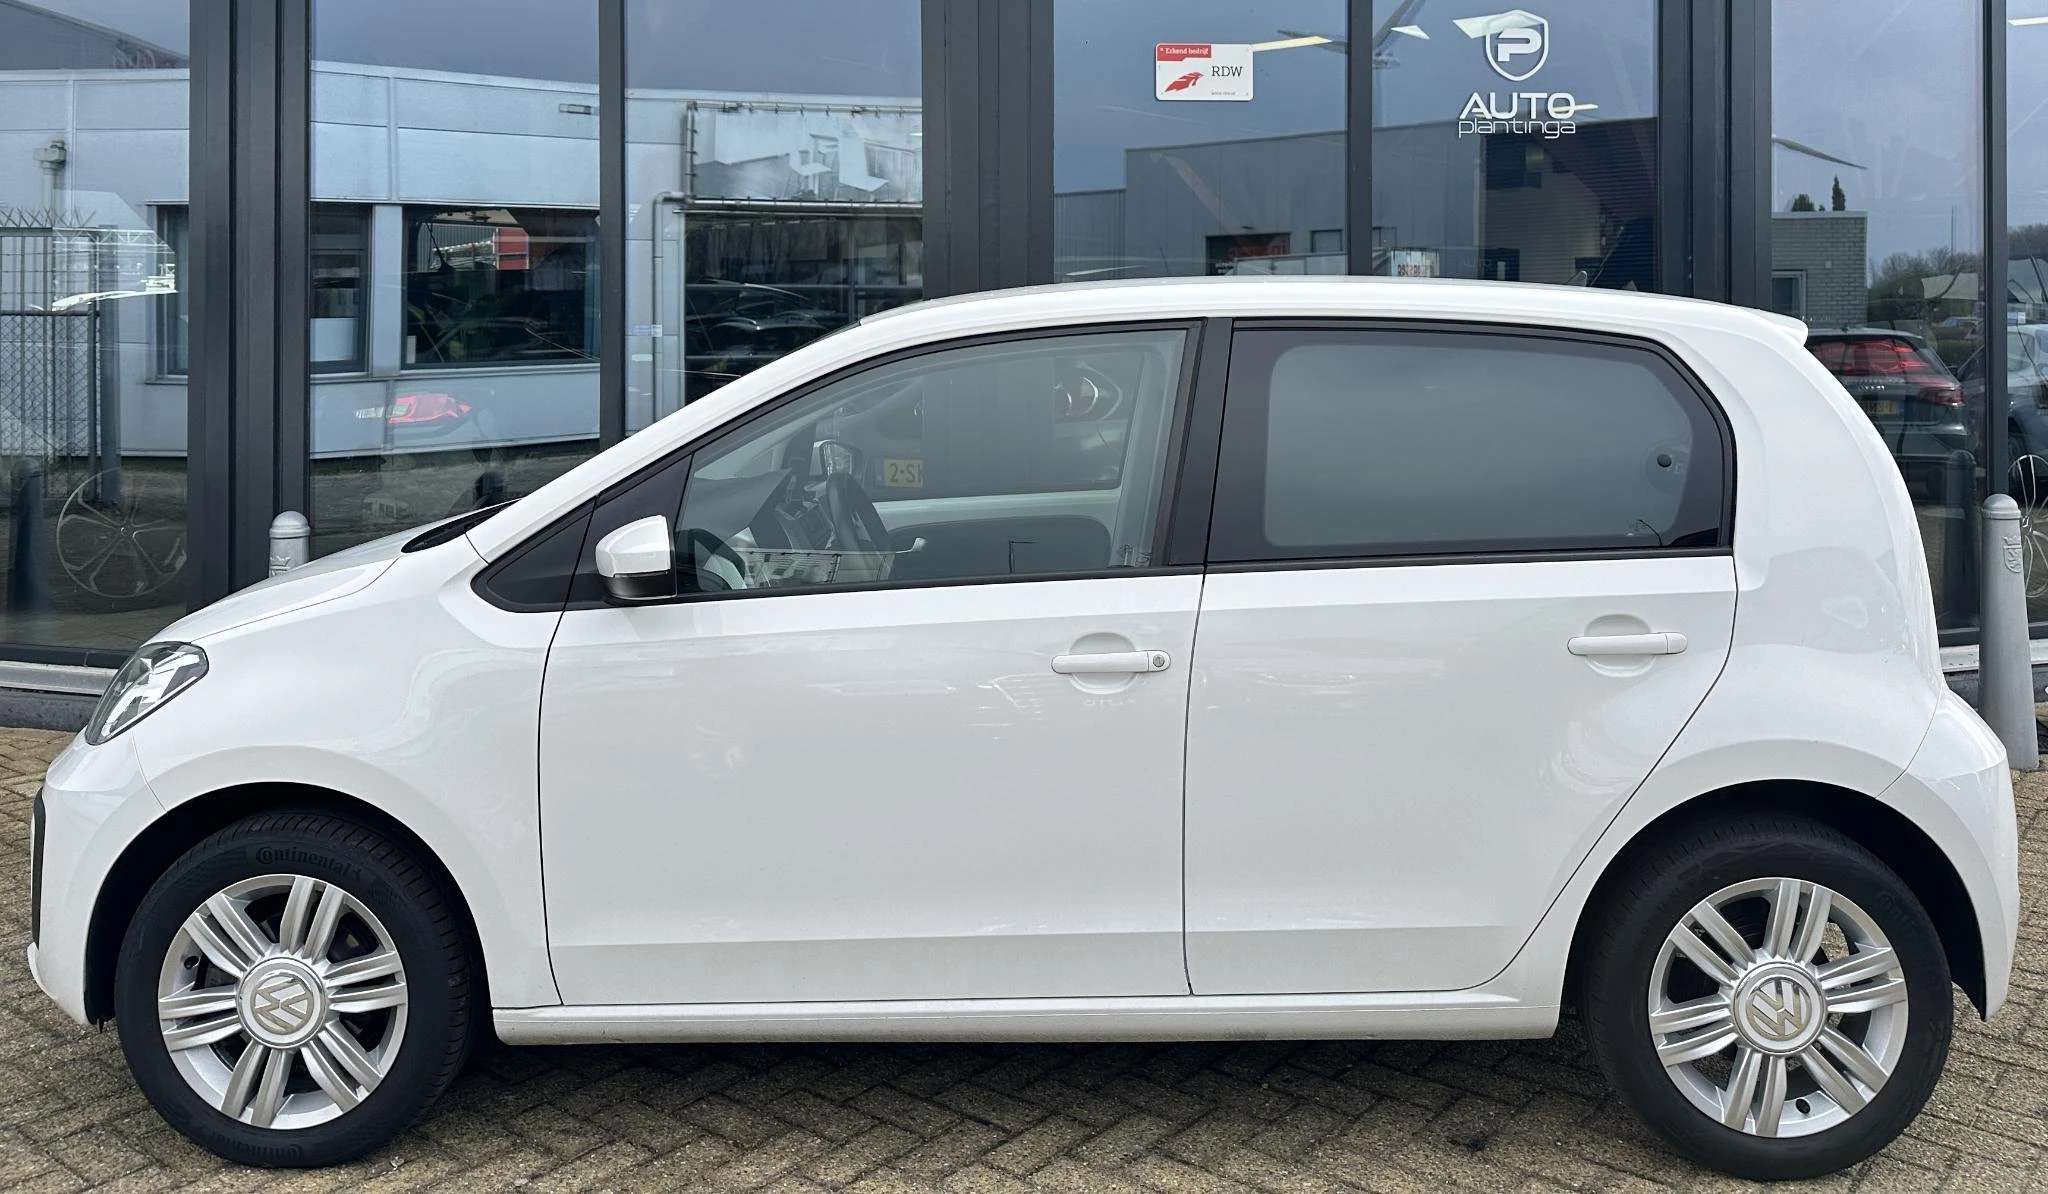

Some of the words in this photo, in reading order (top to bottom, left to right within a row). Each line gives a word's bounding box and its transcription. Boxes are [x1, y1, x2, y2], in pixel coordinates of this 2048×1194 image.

[1211, 65, 1243, 77] RDW
[1459, 92, 1576, 119] AUTO
[1458, 118, 1576, 139] plantinga
[256, 846, 352, 876] Continental
